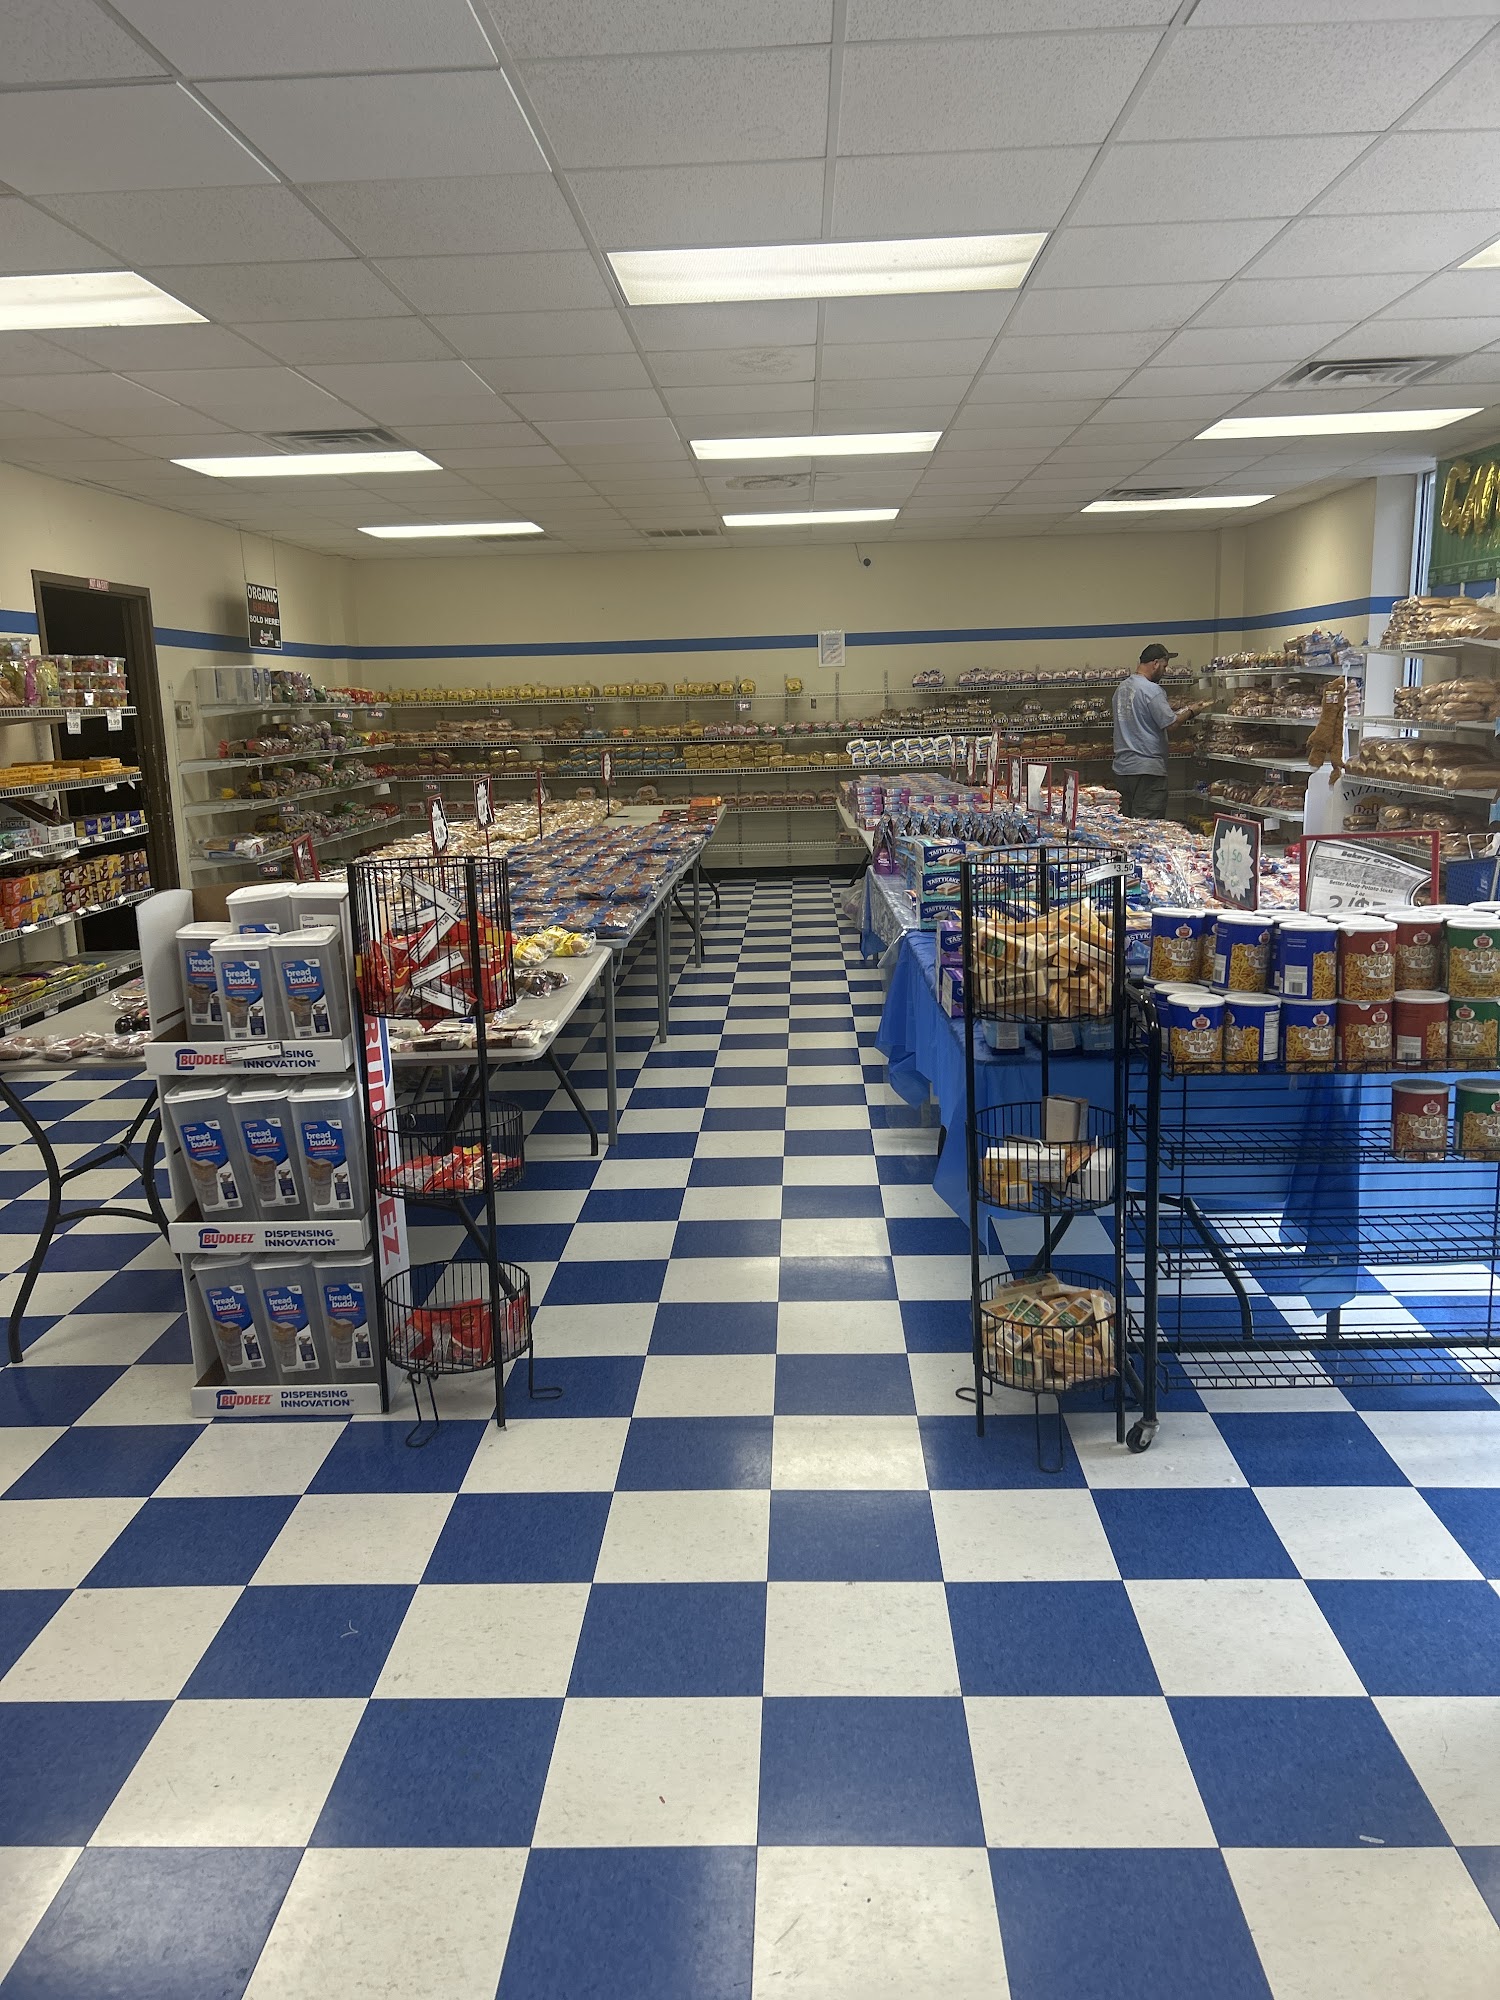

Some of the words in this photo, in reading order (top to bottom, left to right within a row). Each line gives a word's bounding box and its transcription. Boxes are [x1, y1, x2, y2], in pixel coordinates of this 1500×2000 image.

[247, 585, 278, 603] ORGANIC
[253, 602, 275, 615] BREAD
[250, 615, 264, 624] SOLD
[928, 847, 962, 857] TASTYKAKE
[1341, 850, 1372, 862] Bakery
[1373, 858, 1402, 869] Outlet
[1113, 863, 1134, 873] $3.50
[927, 876, 961, 886] TASTYKAKE
[1329, 879, 1346, 887] Better
[189, 957, 213, 966] bread
[225, 968, 250, 978] bread
[286, 967, 312, 978] bread
[228, 975, 256, 986] buddy
[289, 975, 317, 985] buddy
[186, 1131, 211, 1142] bread
[247, 1129, 271, 1138] bread
[306, 1130, 331, 1140] bread
[190, 1139, 217, 1149] buddy
[251, 1136, 277, 1145] buddy
[309, 1137, 337, 1147] buddy
[204, 1233, 254, 1244] BUDDEEZ
[264, 1229, 333, 1238] DISPENSING
[211, 1295, 235, 1305] bread
[268, 1295, 292, 1305] bread
[329, 1293, 352, 1302] bread
[216, 1302, 241, 1312] buddy
[272, 1302, 298, 1312] buddy
[332, 1299, 358, 1308] buddy
[280, 1390, 348, 1399] DISPENSING
[221, 1394, 272, 1406] BUDDEEZ
